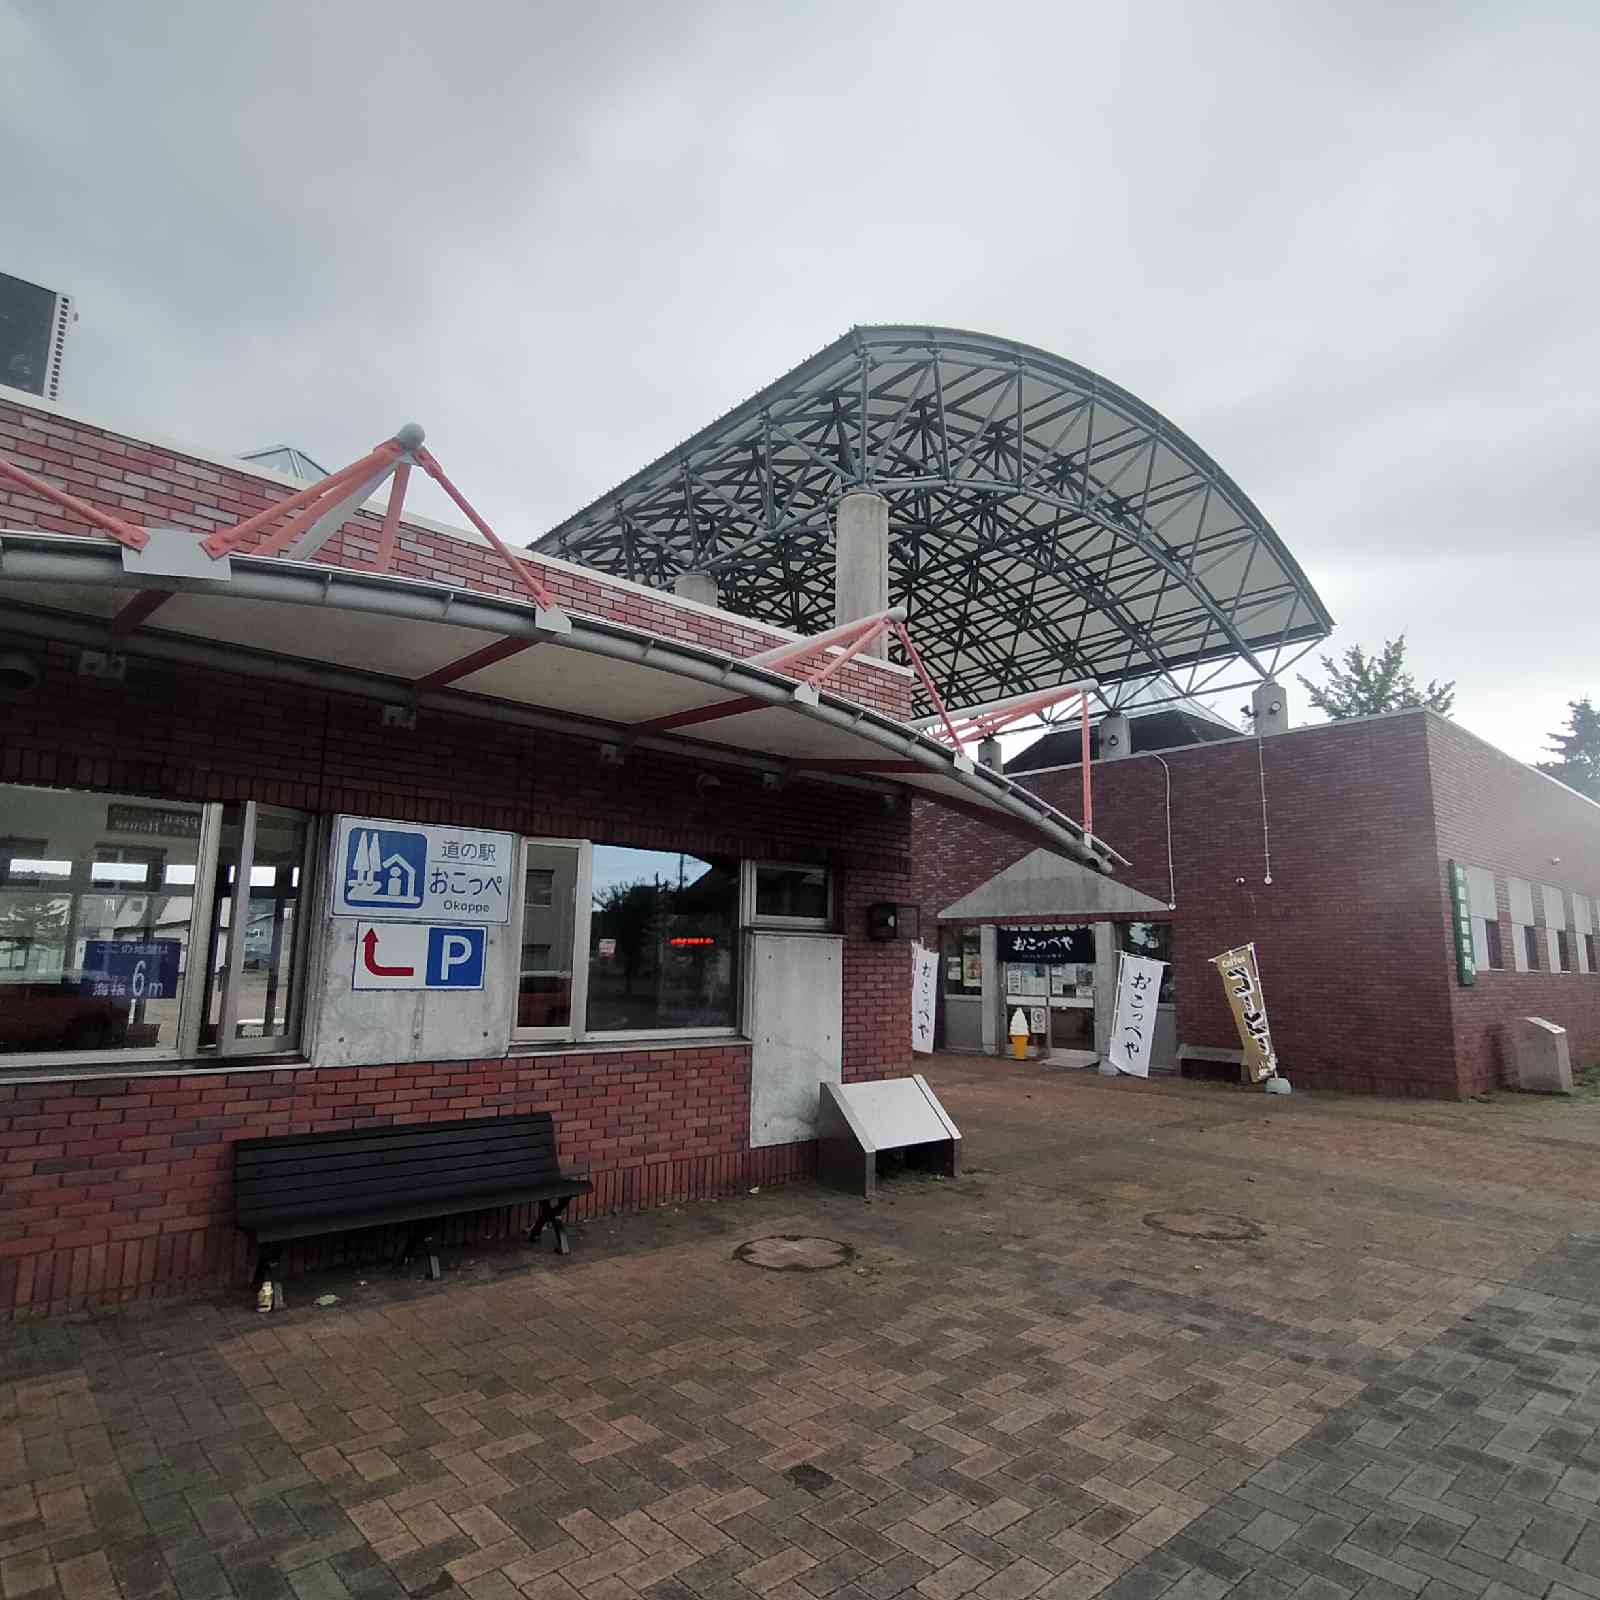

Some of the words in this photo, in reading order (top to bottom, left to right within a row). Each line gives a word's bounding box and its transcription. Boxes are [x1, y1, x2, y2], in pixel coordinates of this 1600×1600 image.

[440, 840, 496, 862] 道の駅
[429, 867, 502, 896] おこっぺ
[443, 900, 490, 913] Okoppe
[441, 935, 472, 980] P
[132, 960, 146, 996] 6
[149, 982, 163, 996] m
